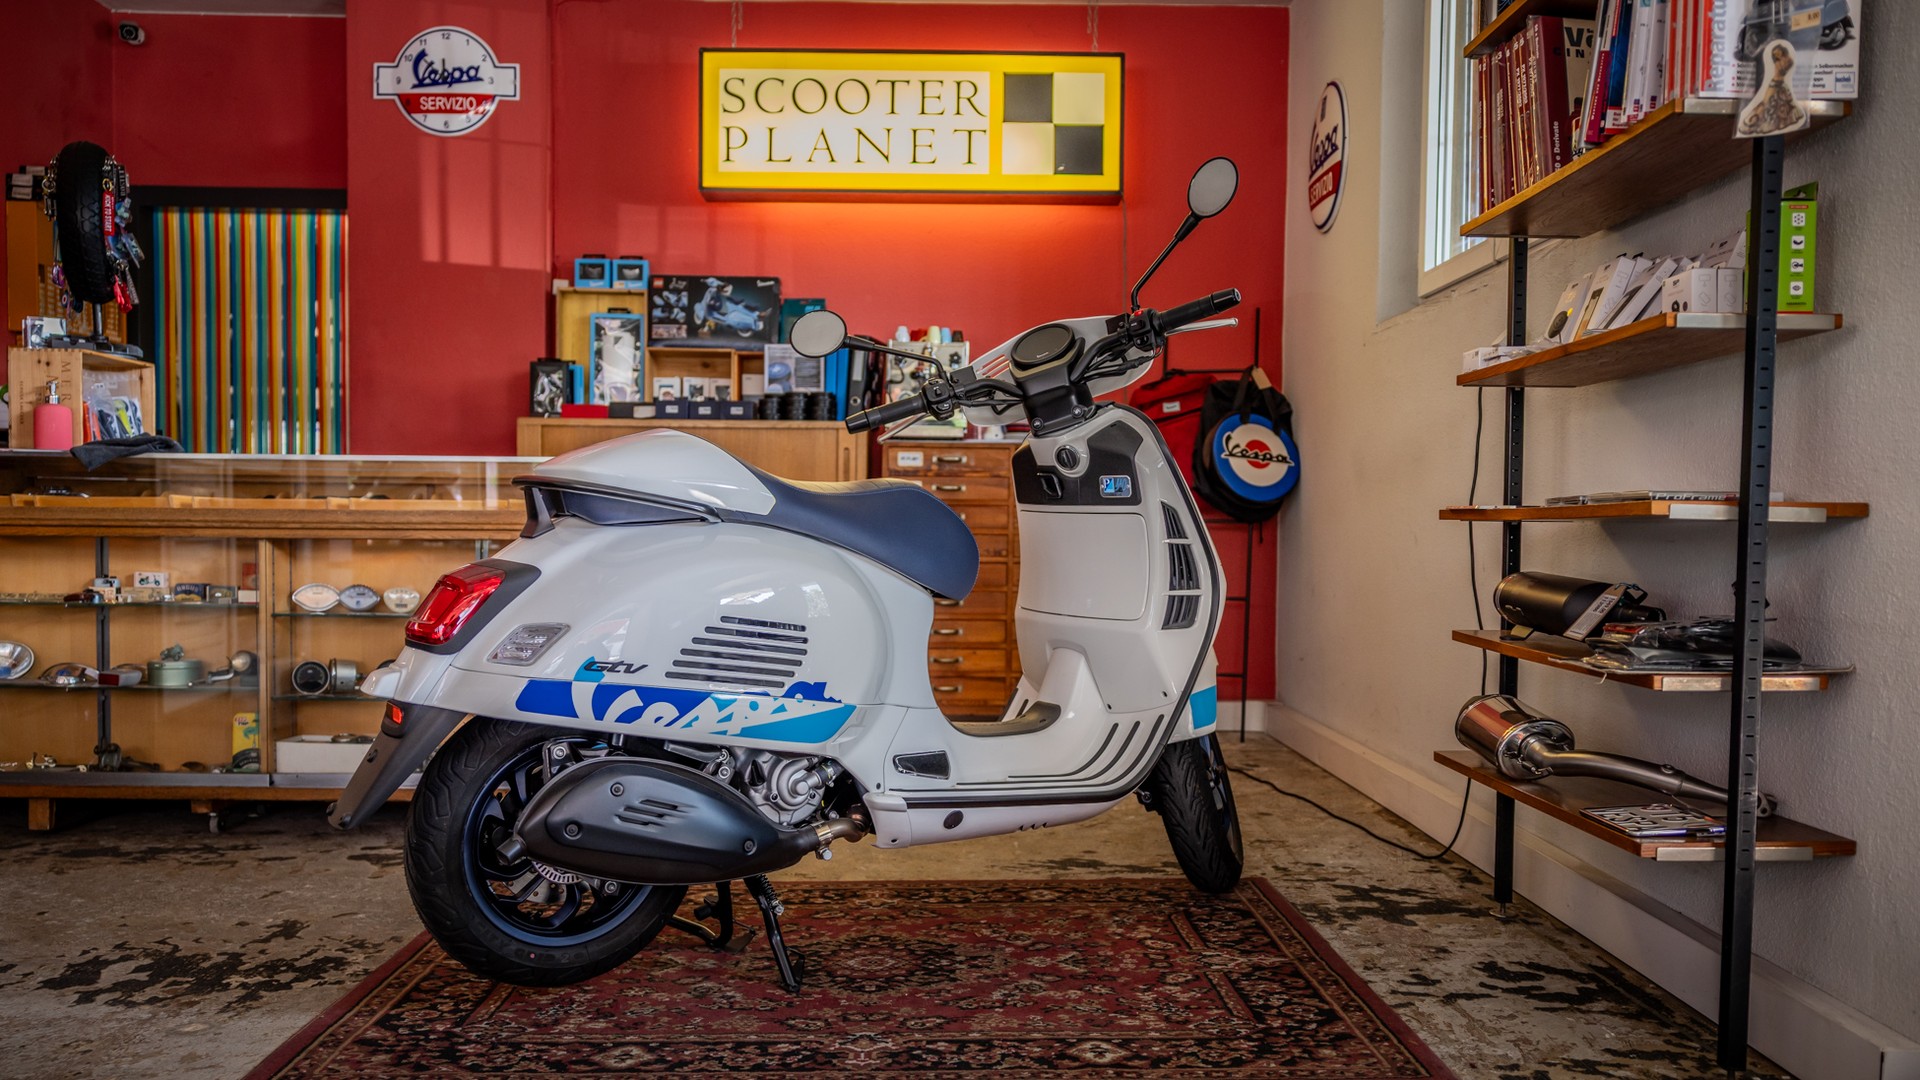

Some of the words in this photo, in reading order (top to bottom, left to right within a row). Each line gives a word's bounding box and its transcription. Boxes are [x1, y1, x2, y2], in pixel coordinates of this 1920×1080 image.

[404, 54, 413, 62] 10
[410, 48, 484, 90] Vespa
[420, 96, 477, 111] SERVIZIO
[722, 77, 988, 117] SCOOTER
[722, 126, 987, 166] PLANET
[1223, 433, 1293, 465] Vespa
[572, 656, 846, 736] Vespa
